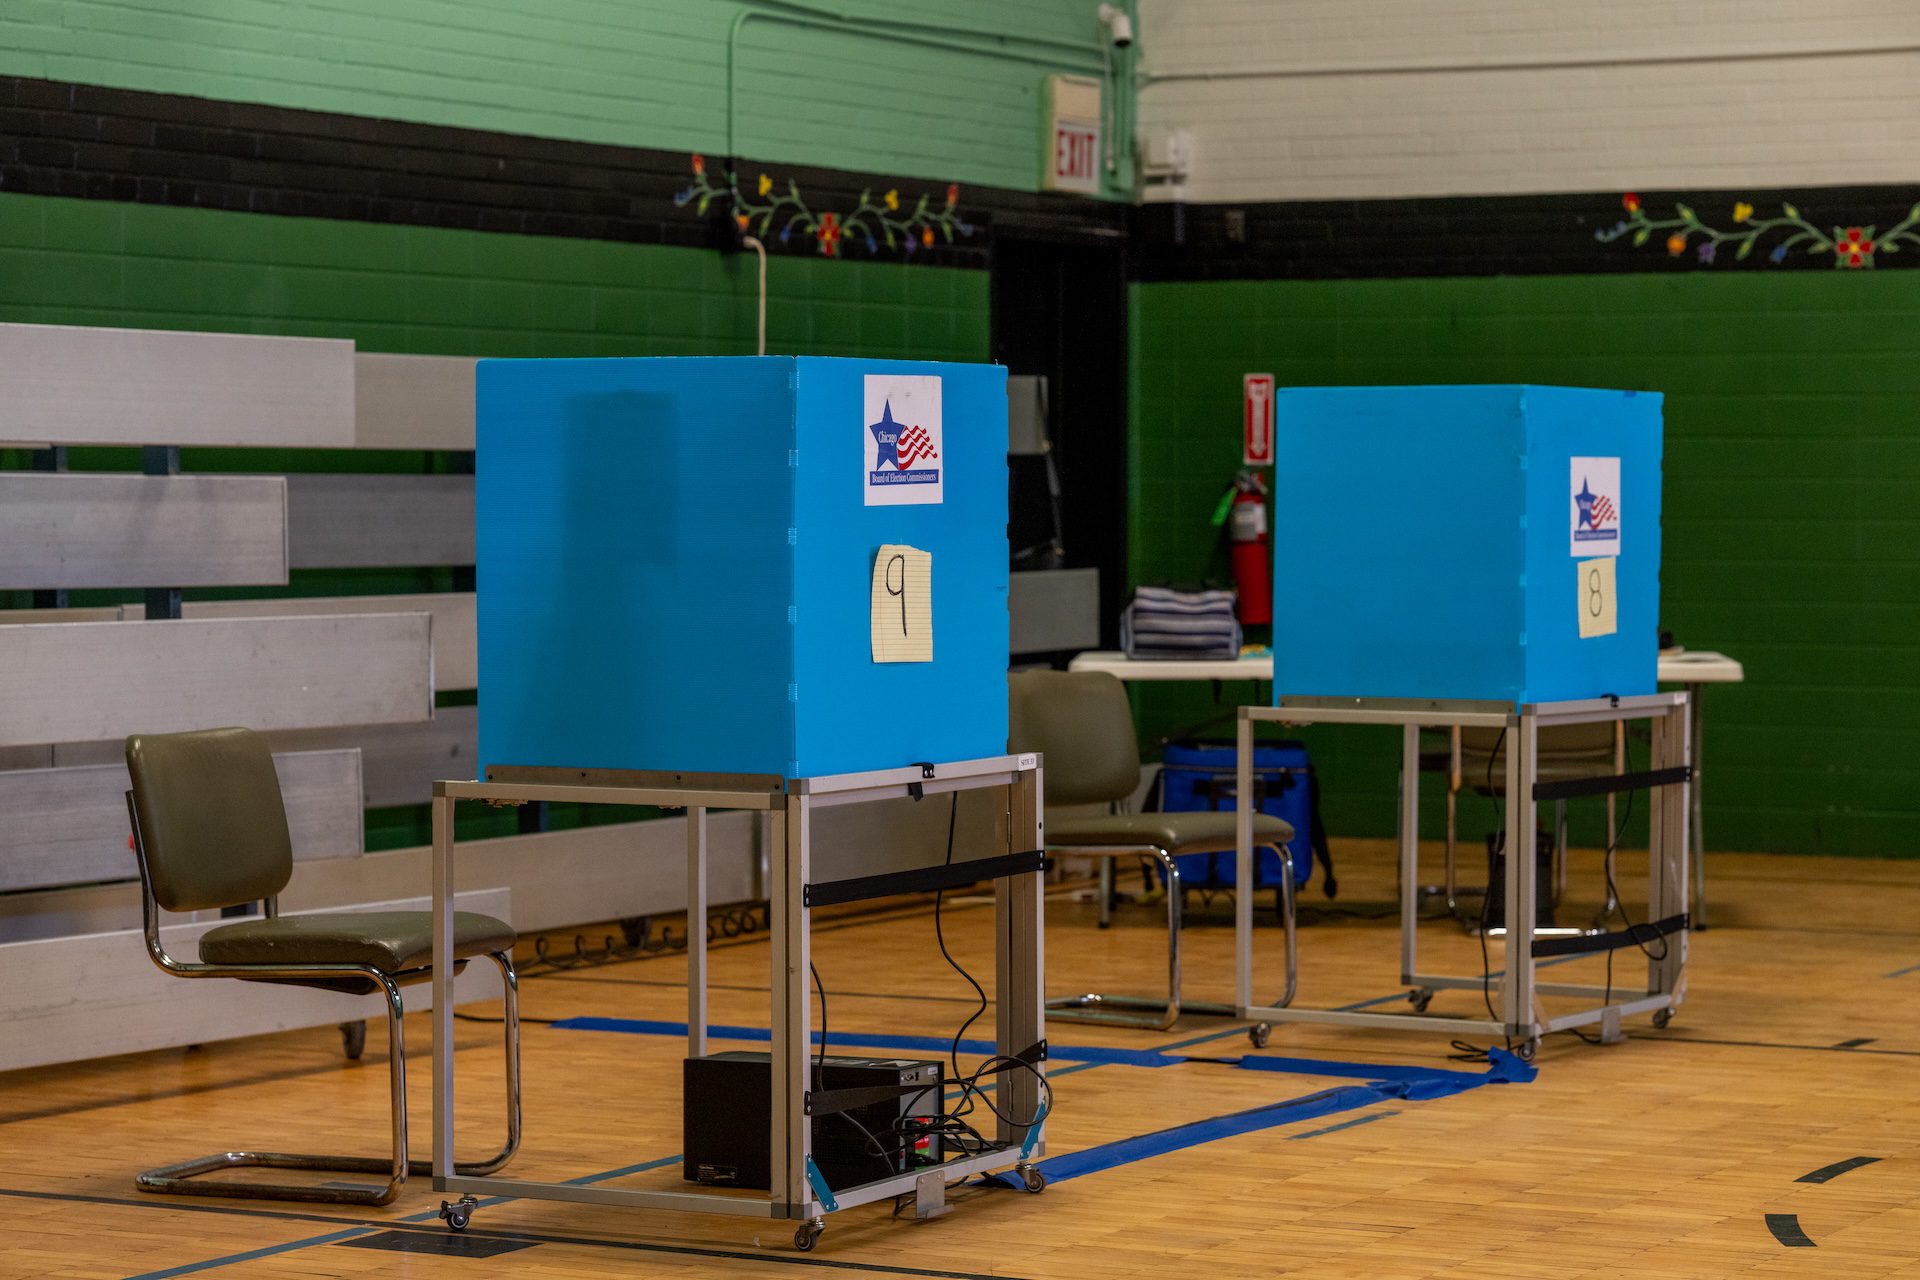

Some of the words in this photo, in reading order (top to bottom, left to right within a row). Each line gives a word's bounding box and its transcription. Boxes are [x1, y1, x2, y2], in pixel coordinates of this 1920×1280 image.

[1057, 129, 1096, 179] EXIT
[878, 430, 898, 446] Chicago
[872, 473, 885, 483] Board
[890, 473, 907, 482] Election
[907, 472, 937, 482] Commissioners
[886, 553, 907, 638] 9
[1589, 568, 1603, 617] 8
